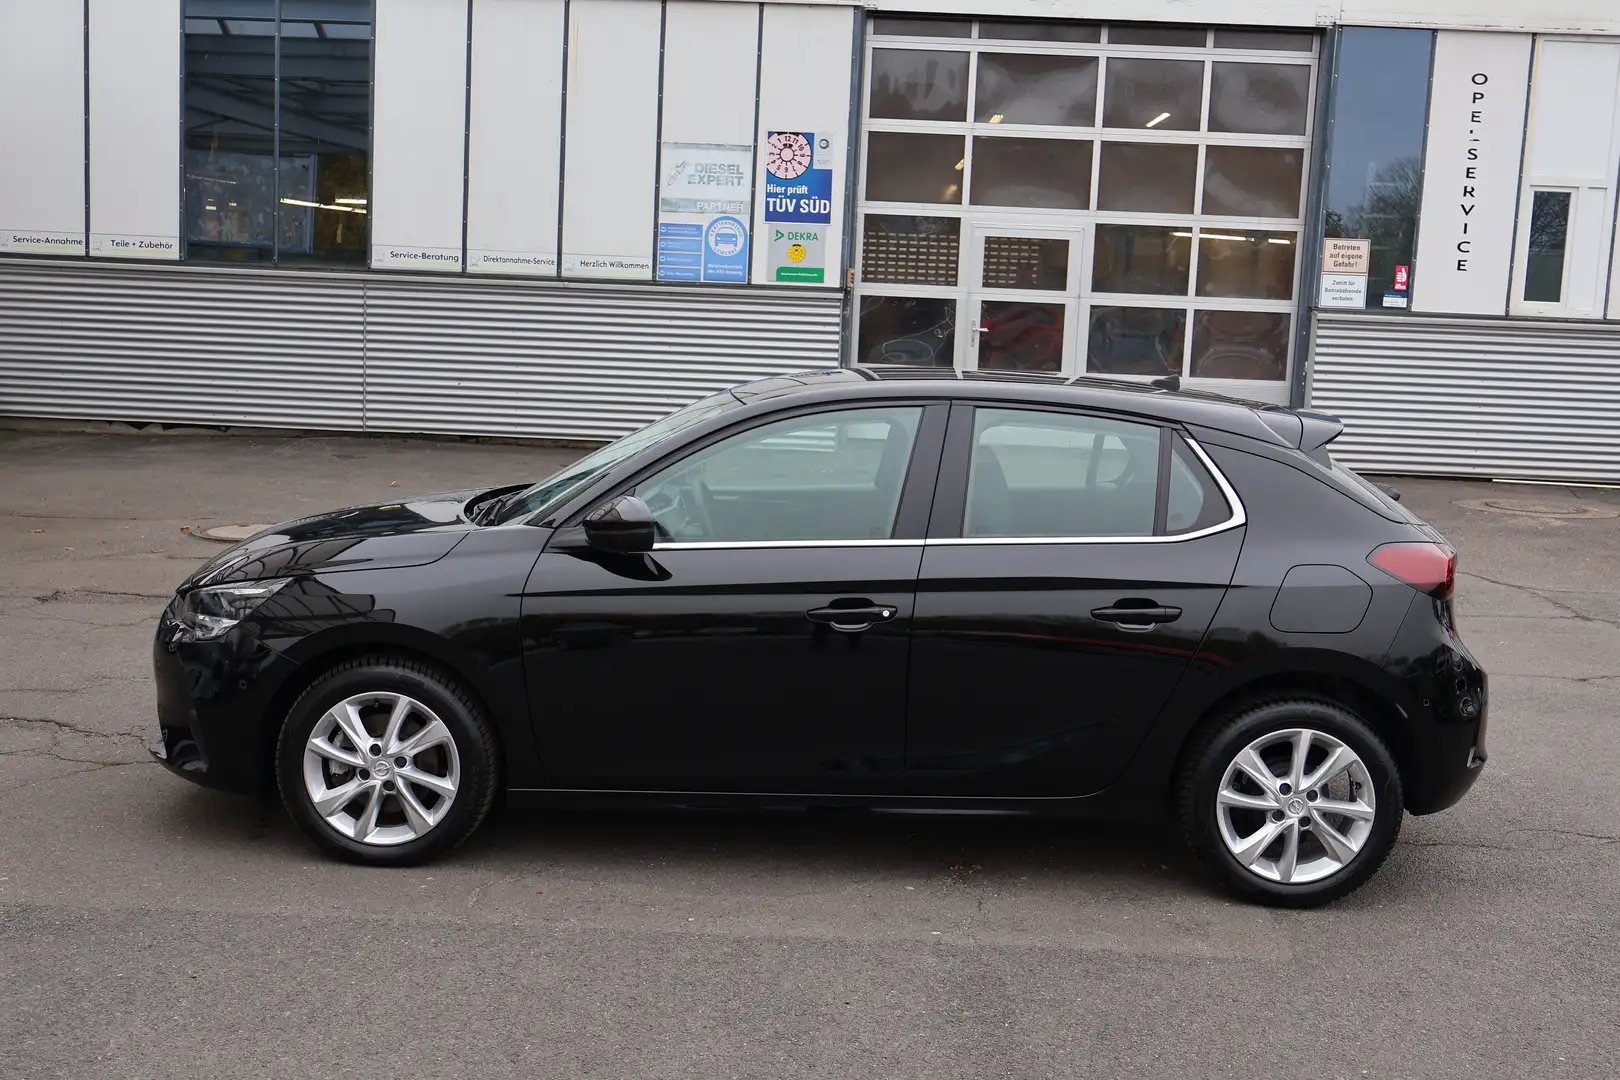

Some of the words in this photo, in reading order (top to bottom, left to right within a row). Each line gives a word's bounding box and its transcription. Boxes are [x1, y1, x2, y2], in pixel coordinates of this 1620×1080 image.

[694, 163, 744, 175] DIESEL
[687, 174, 744, 187] EXPERT
[766, 184, 786, 193] Hier
[787, 185, 808, 196] prüft
[696, 200, 743, 213] PARTNER
[766, 195, 796, 212] TÜV
[799, 196, 830, 213] SÜD
[12, 235, 83, 246] Service-Annahme
[787, 231, 819, 241] DEKRA
[110, 239, 130, 248] Teile
[138, 240, 173, 250] Zubehör
[1333, 243, 1360, 251] Betreten
[390, 251, 459, 263] Service-Beratung
[483, 255, 555, 266] Direktannahme-Service
[580, 260, 608, 268] Herzlich
[609, 261, 650, 270] Willkommen
[1333, 260, 1358, 268] Gefahr!
